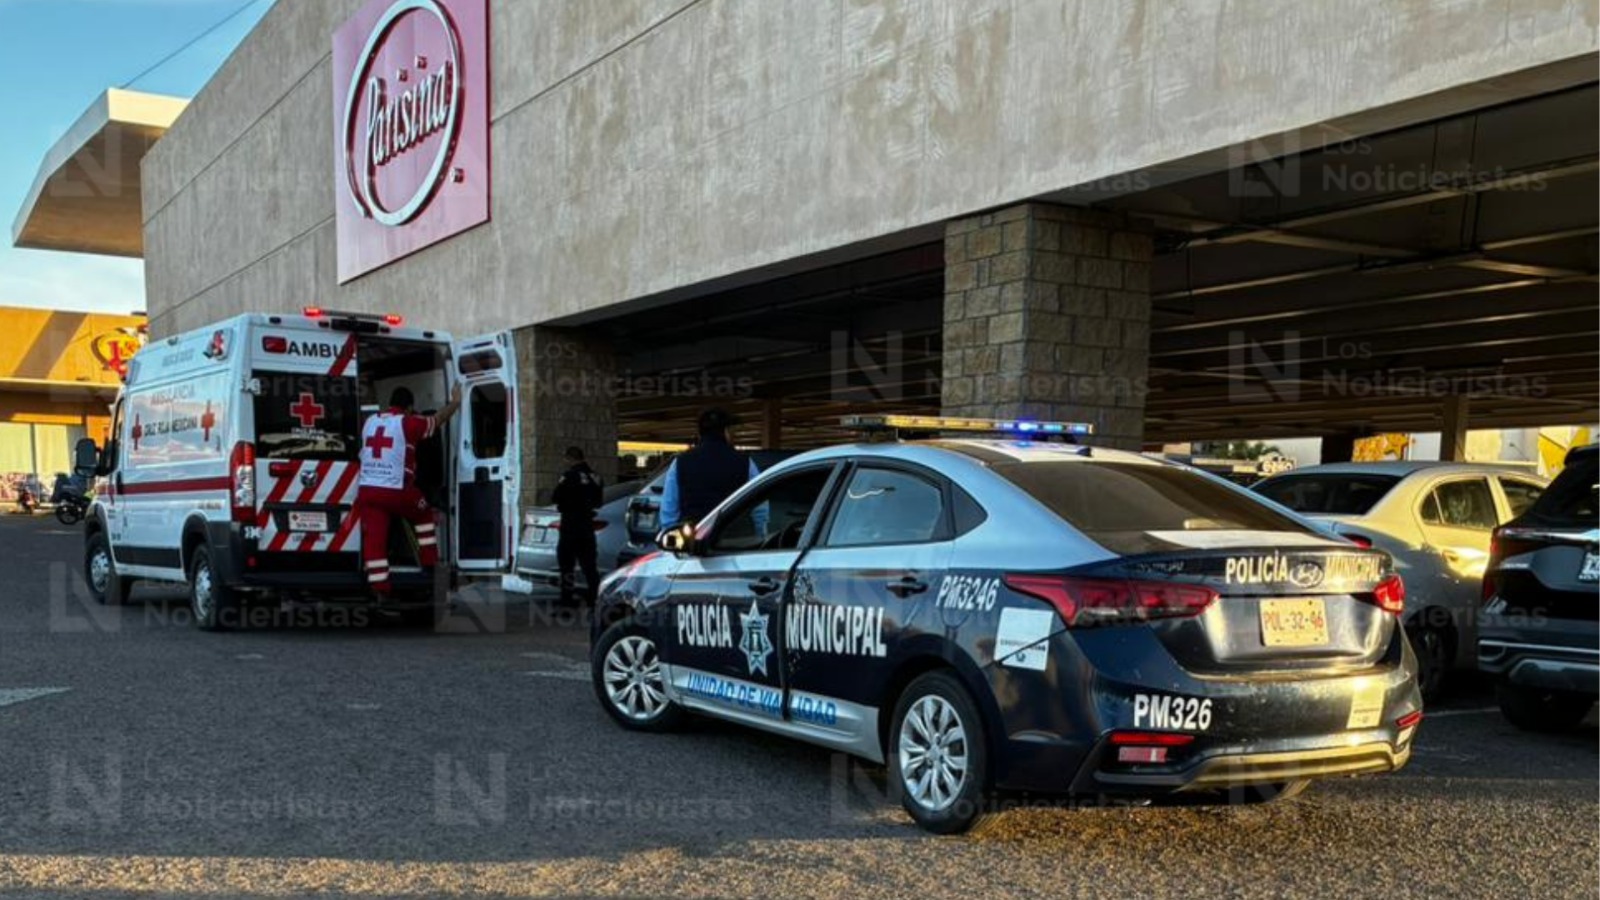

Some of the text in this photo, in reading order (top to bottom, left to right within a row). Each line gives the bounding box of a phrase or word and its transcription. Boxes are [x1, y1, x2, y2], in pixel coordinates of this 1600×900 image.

[366, 55, 454, 166] Parisina
[1225, 550, 1289, 585] POLICÍA
[936, 575, 1000, 612] PM3246
[677, 597, 733, 648] POLICÍA
[785, 603, 888, 658] MUNICIPAL
[687, 671, 736, 702] UNIDAD
[737, 685, 758, 706] DE
[1133, 693, 1213, 730] PM326
